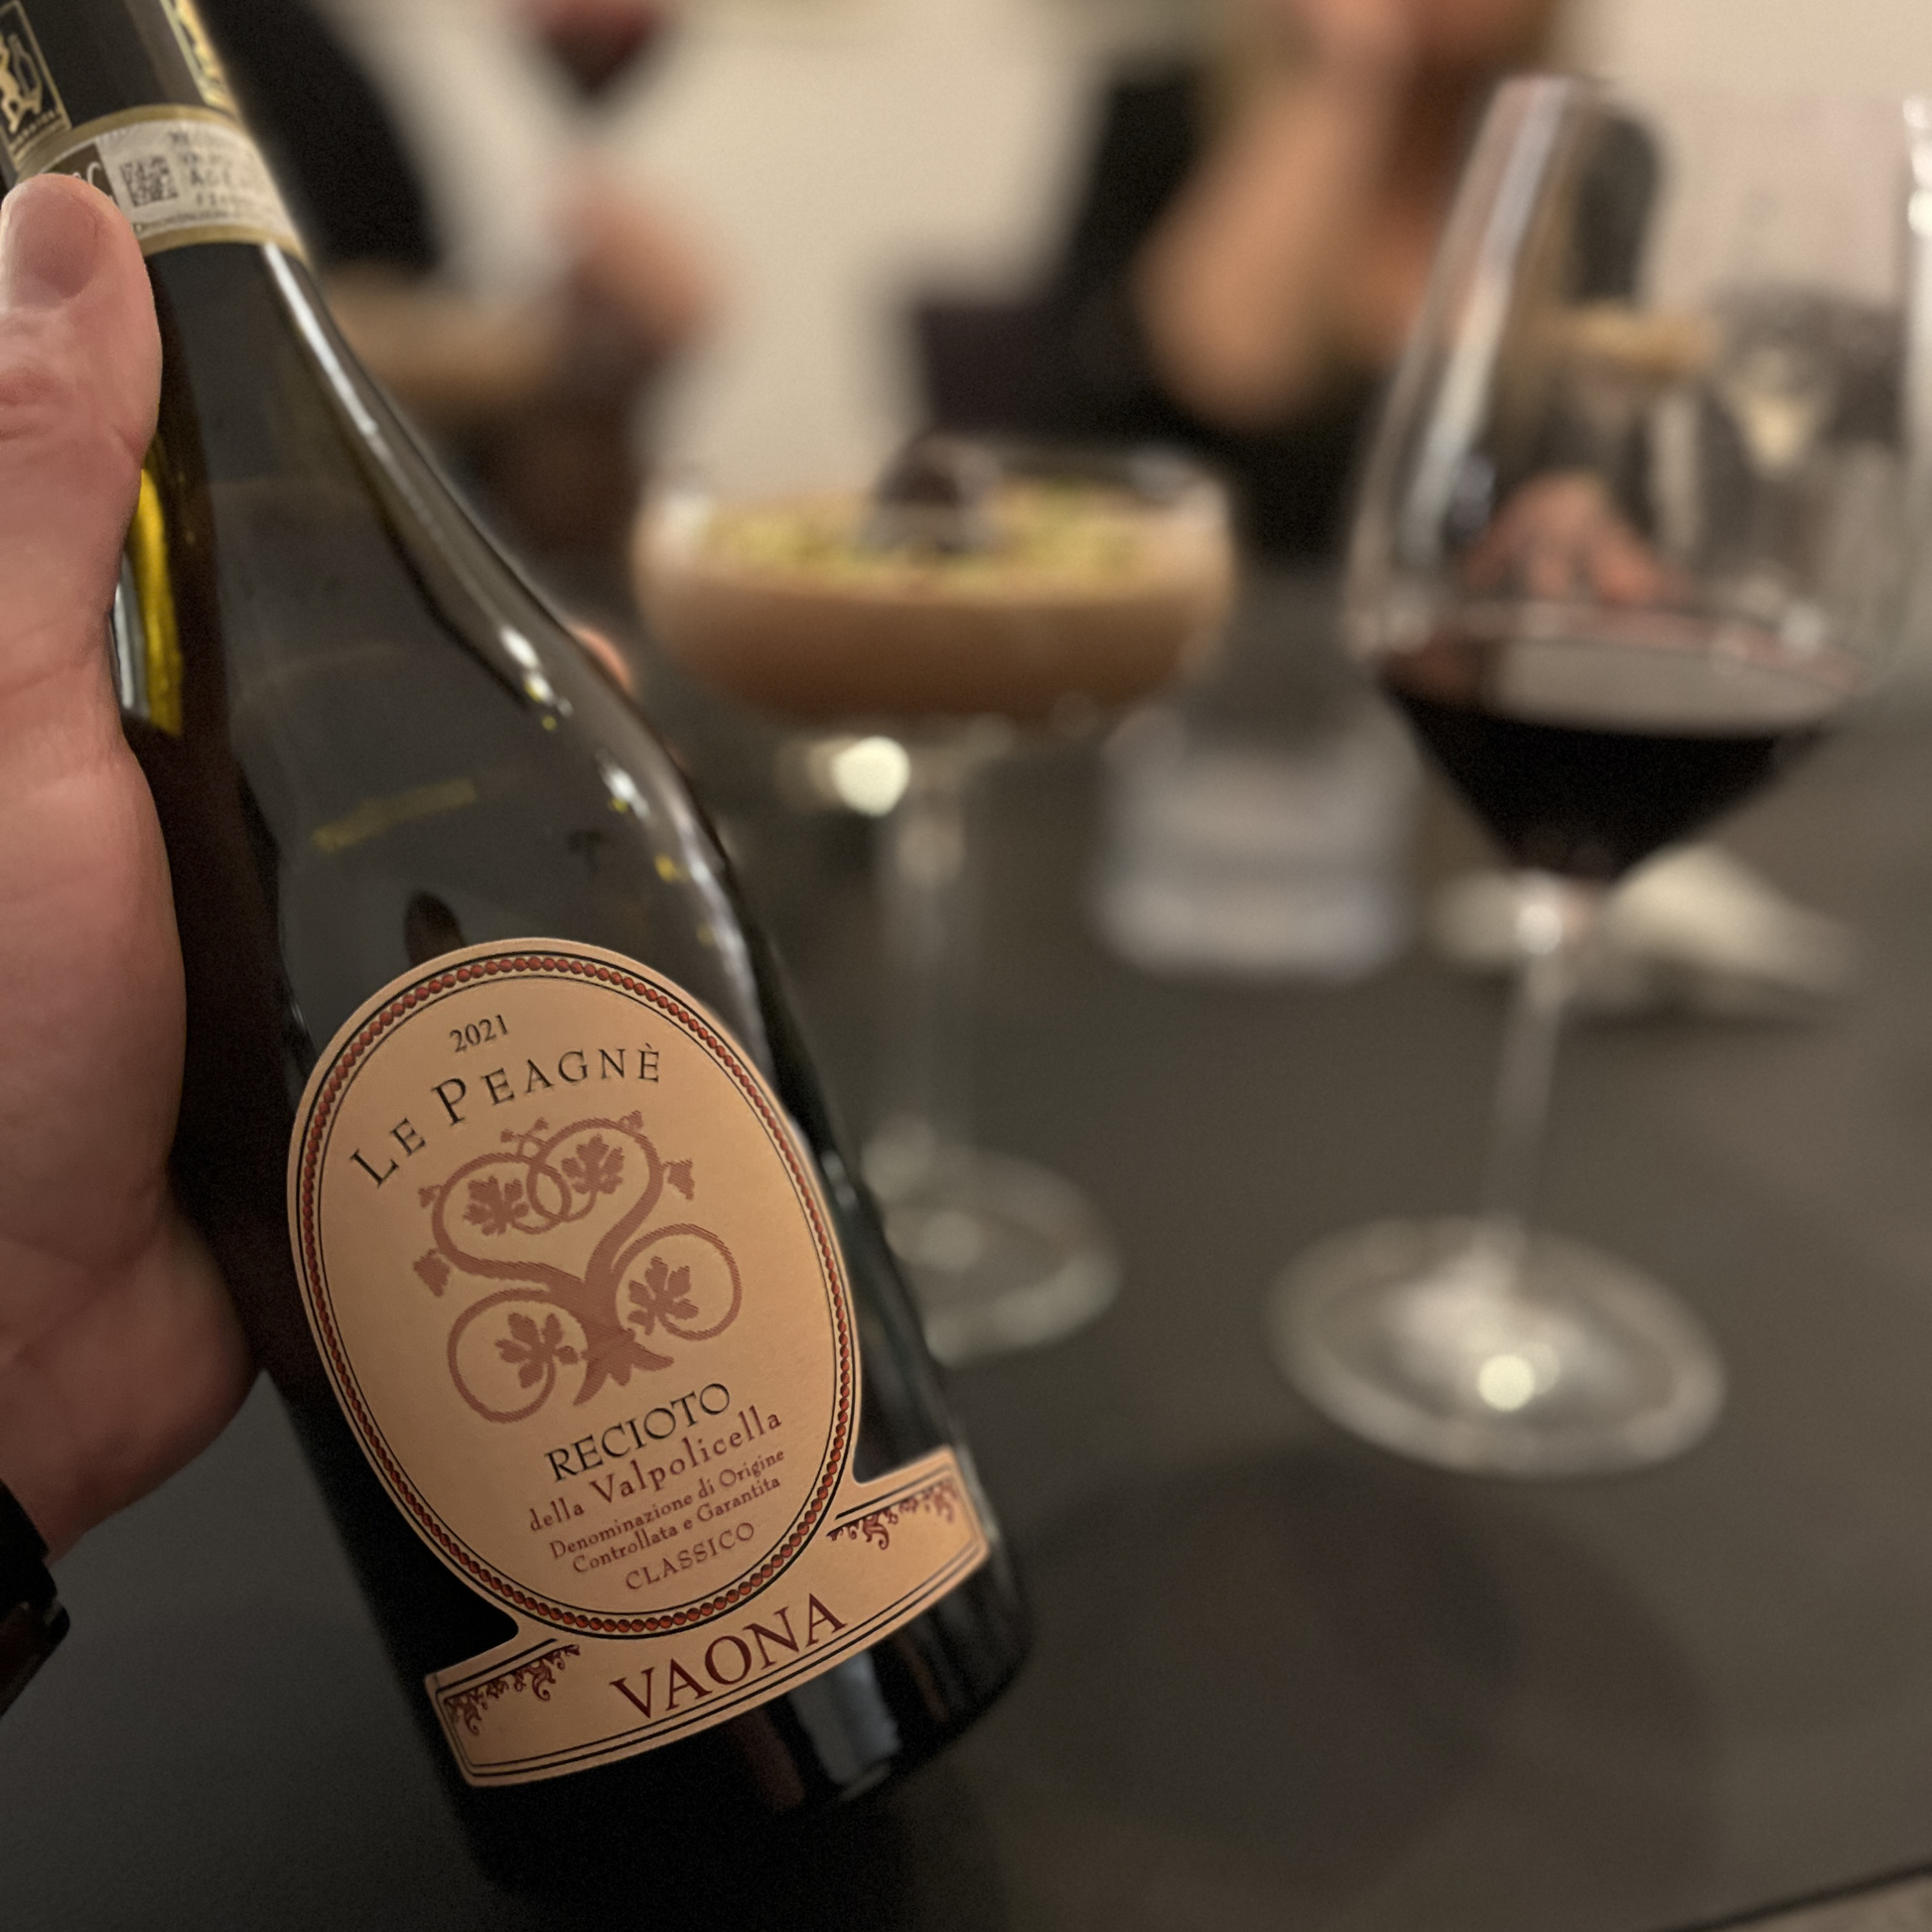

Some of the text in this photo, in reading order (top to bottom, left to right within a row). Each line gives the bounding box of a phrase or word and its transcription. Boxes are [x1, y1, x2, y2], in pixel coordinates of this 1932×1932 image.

[450, 1014, 508, 1053] 2021
[350, 1043, 660, 1187] LE PEAGNÈ
[529, 1406, 781, 1532] della Valpolicella
[544, 1383, 730, 1482] RECIOTO
[550, 1449, 784, 1560] Denominazione di Origine
[573, 1475, 780, 1574] Controllata e Garantita
[625, 1522, 755, 1590] CLASSICO
[610, 1592, 848, 1720] VAONA
